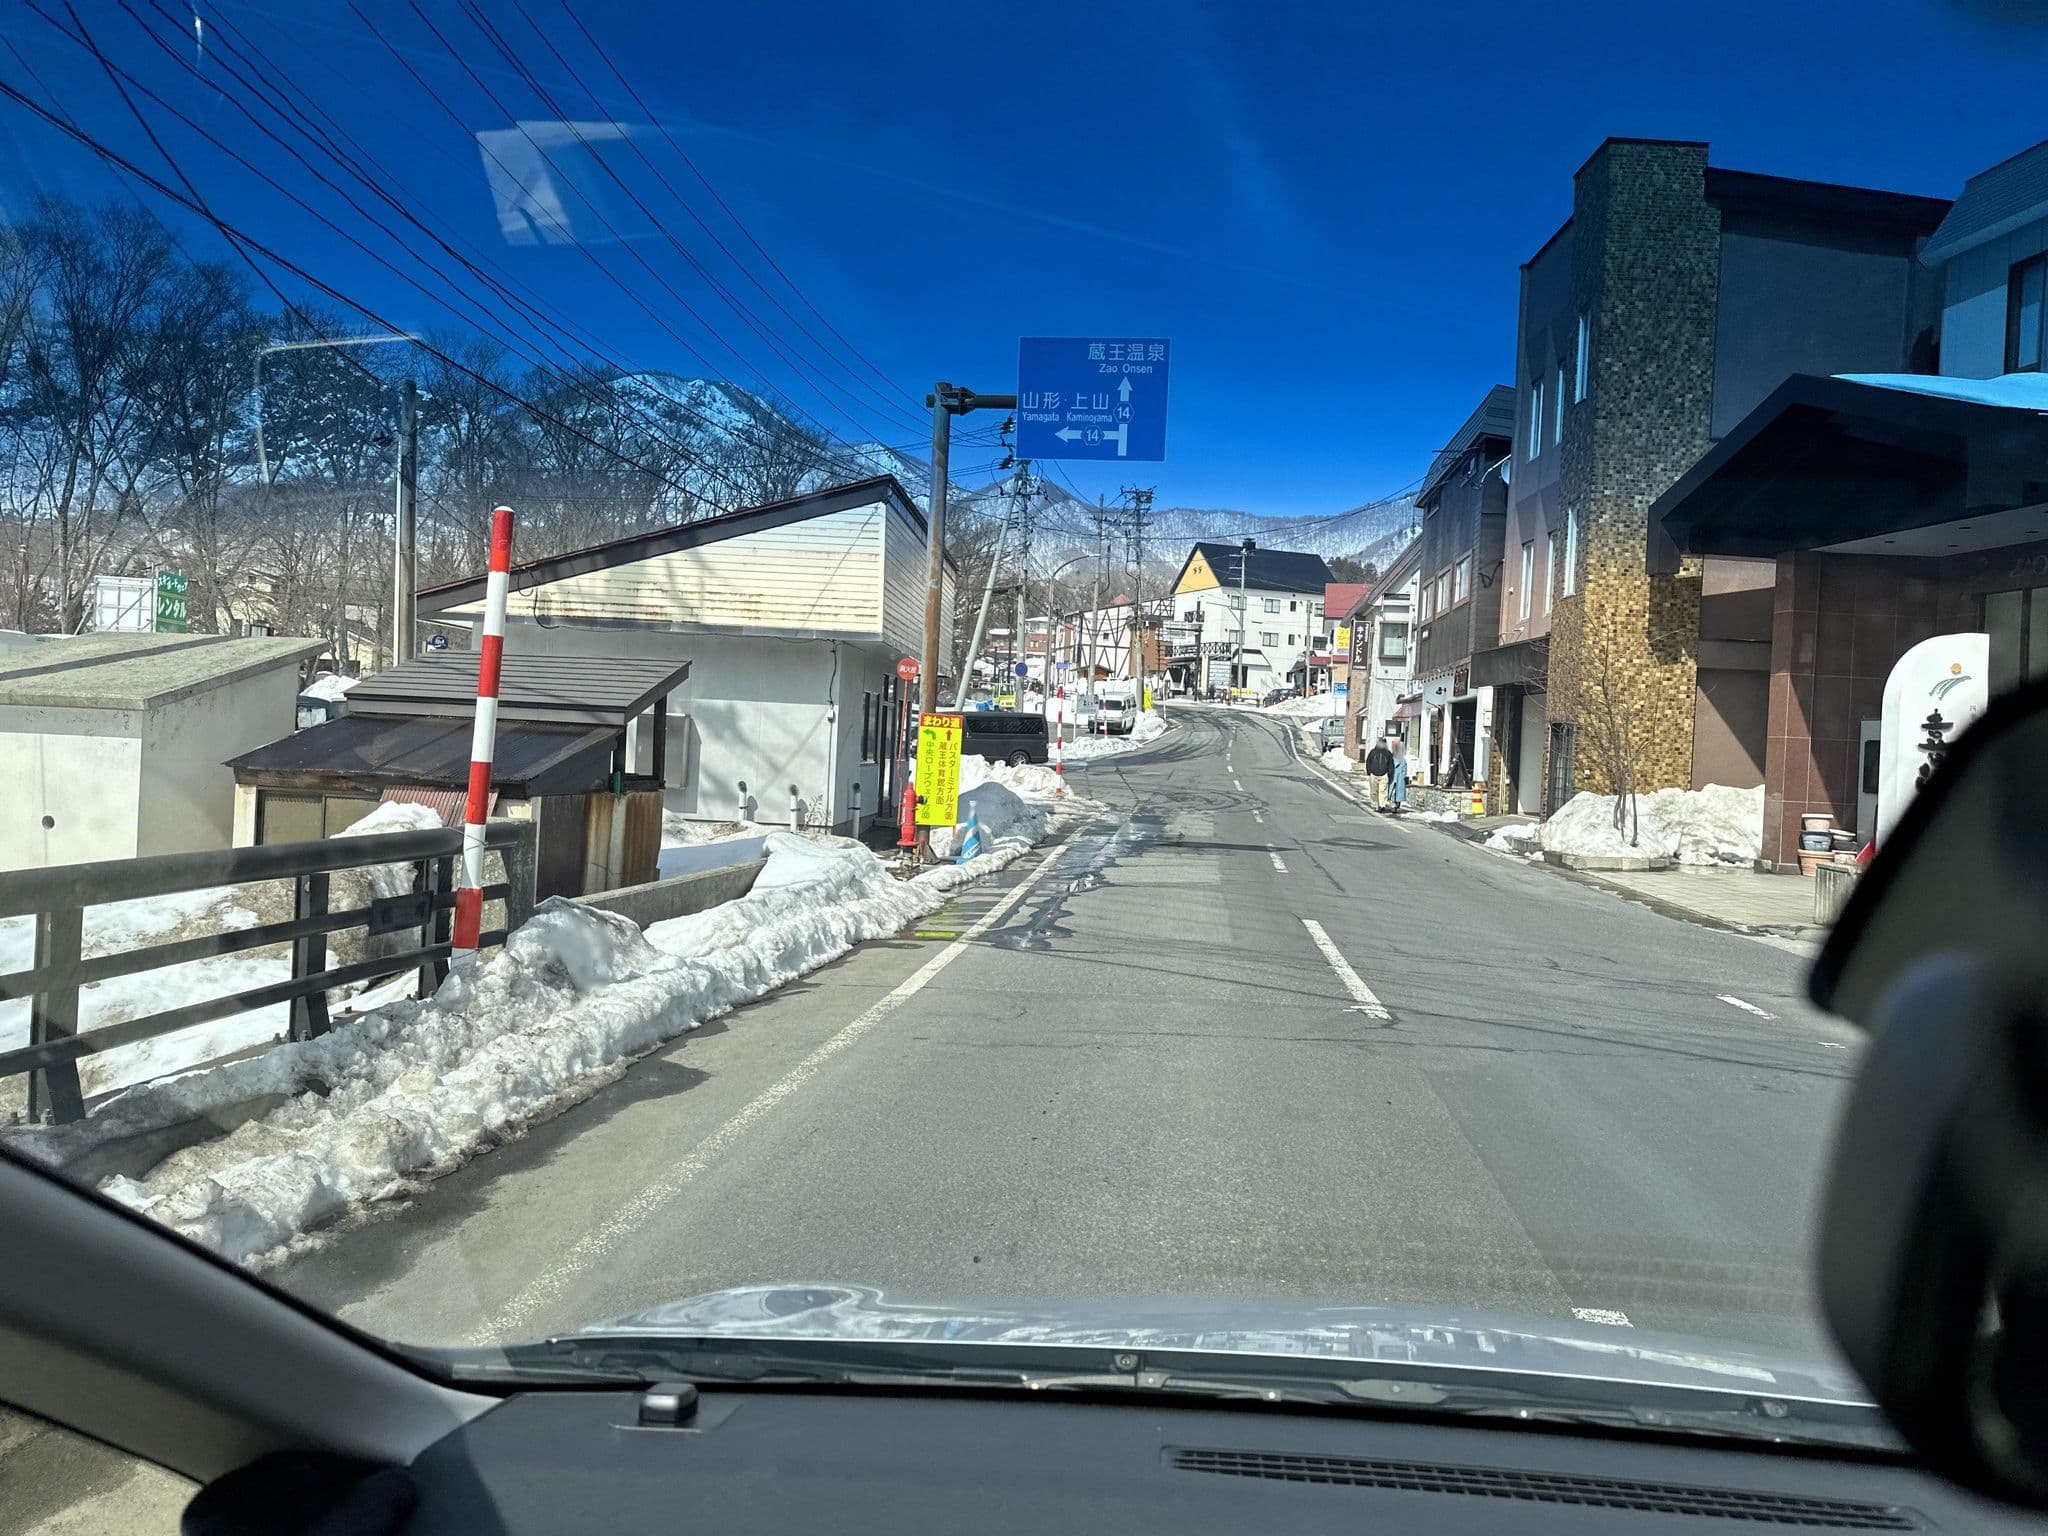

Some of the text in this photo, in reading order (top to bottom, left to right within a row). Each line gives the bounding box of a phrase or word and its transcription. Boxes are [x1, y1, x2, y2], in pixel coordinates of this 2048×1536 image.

[1088, 343, 1165, 361] 蔵王温泉
[1099, 363, 1153, 374] Zao Onsen
[1022, 412, 1113, 424] Yamagata Kaminoyama
[1117, 407, 1130, 419] 14
[1086, 429, 1099, 442] 14
[158, 596, 187, 618] レンタル
[1354, 626, 1364, 663] キャンドル
[923, 715, 961, 728] まわり道
[921, 741, 935, 819] 中央ロープウェ方面
[936, 742, 947, 805] 蔵王体育館方面
[945, 742, 958, 820] バスターミナル方面
